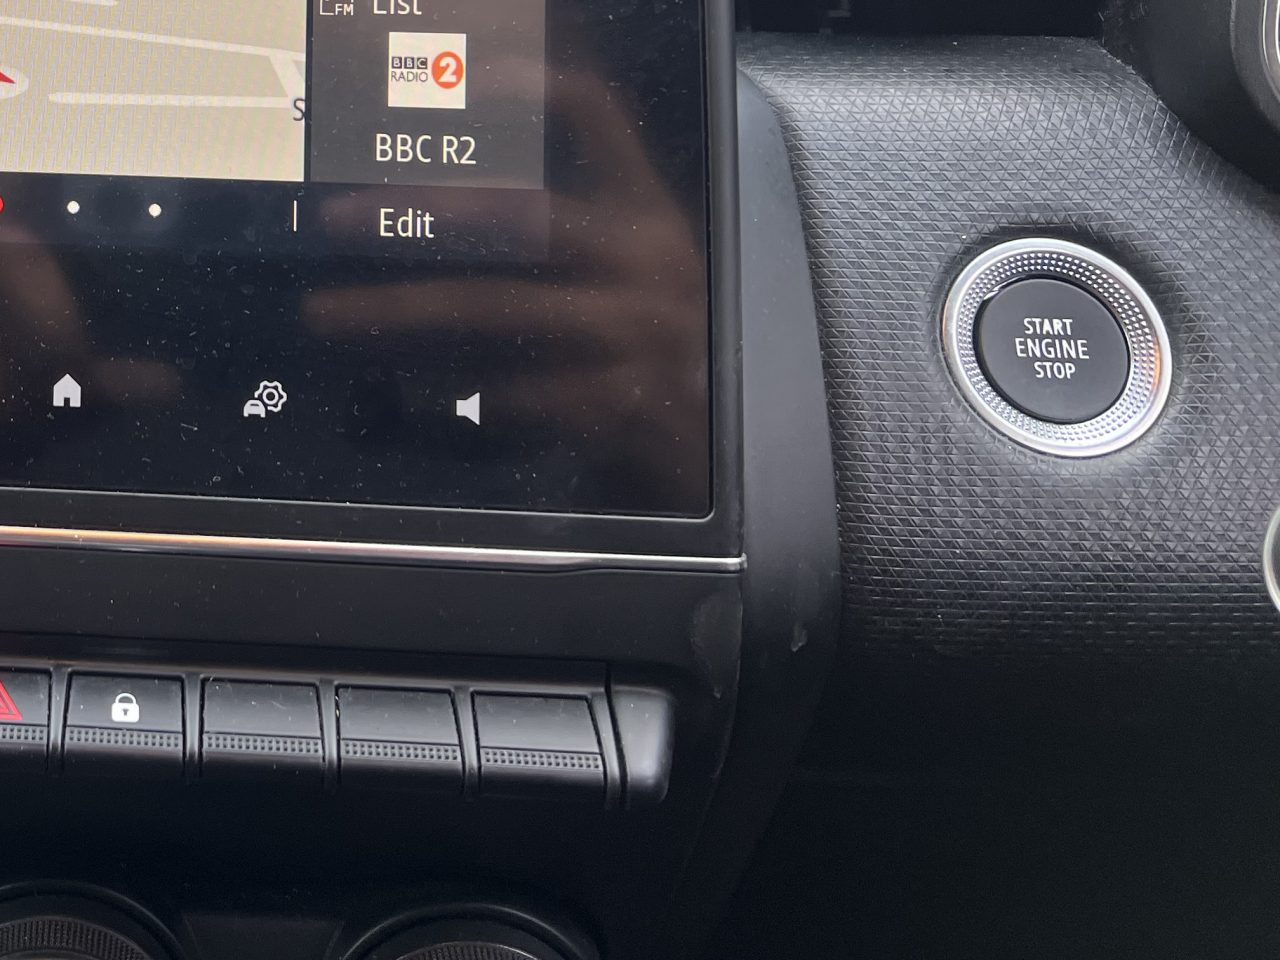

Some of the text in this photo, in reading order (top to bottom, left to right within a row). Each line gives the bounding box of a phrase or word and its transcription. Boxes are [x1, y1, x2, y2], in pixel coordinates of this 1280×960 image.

[334, 3, 354, 16] FM
[391, 56, 428, 70] BBC
[438, 56, 457, 83] 2
[391, 70, 429, 83] RADIO
[375, 133, 477, 165] BBC R2
[379, 207, 435, 239] Edit
[1023, 317, 1073, 336] START
[1014, 337, 1090, 360] ENGINE
[1033, 361, 1076, 380] STOP
